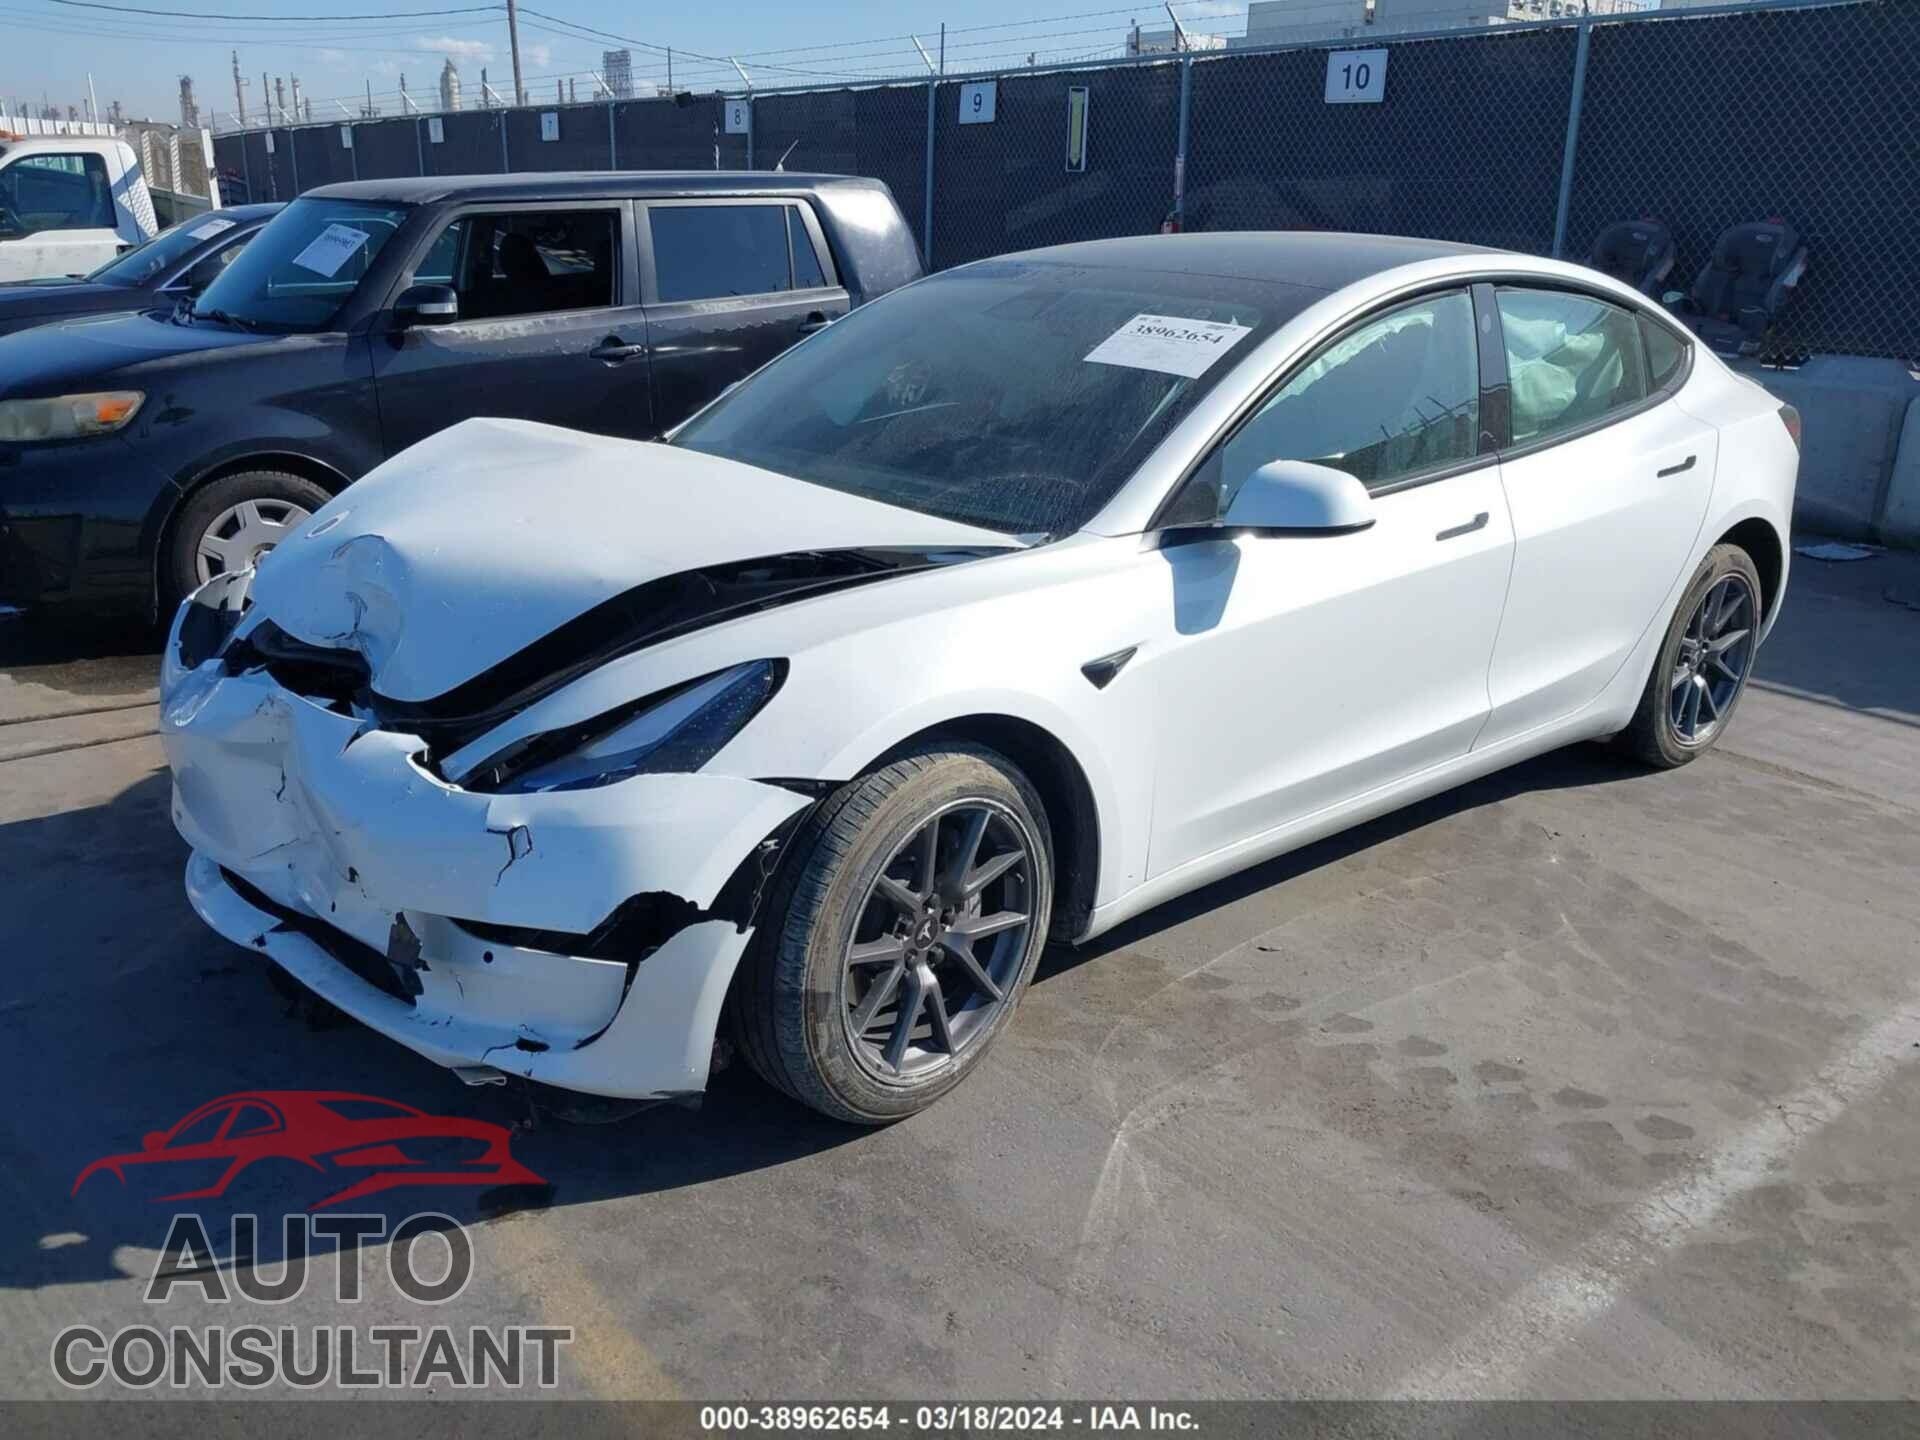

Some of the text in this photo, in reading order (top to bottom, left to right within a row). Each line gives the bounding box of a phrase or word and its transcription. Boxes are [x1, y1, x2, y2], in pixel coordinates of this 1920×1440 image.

[1342, 63, 1370, 90] 10
[973, 93, 982, 113] 9
[734, 108, 742, 126] 8
[1129, 324, 1225, 345] 38962654
